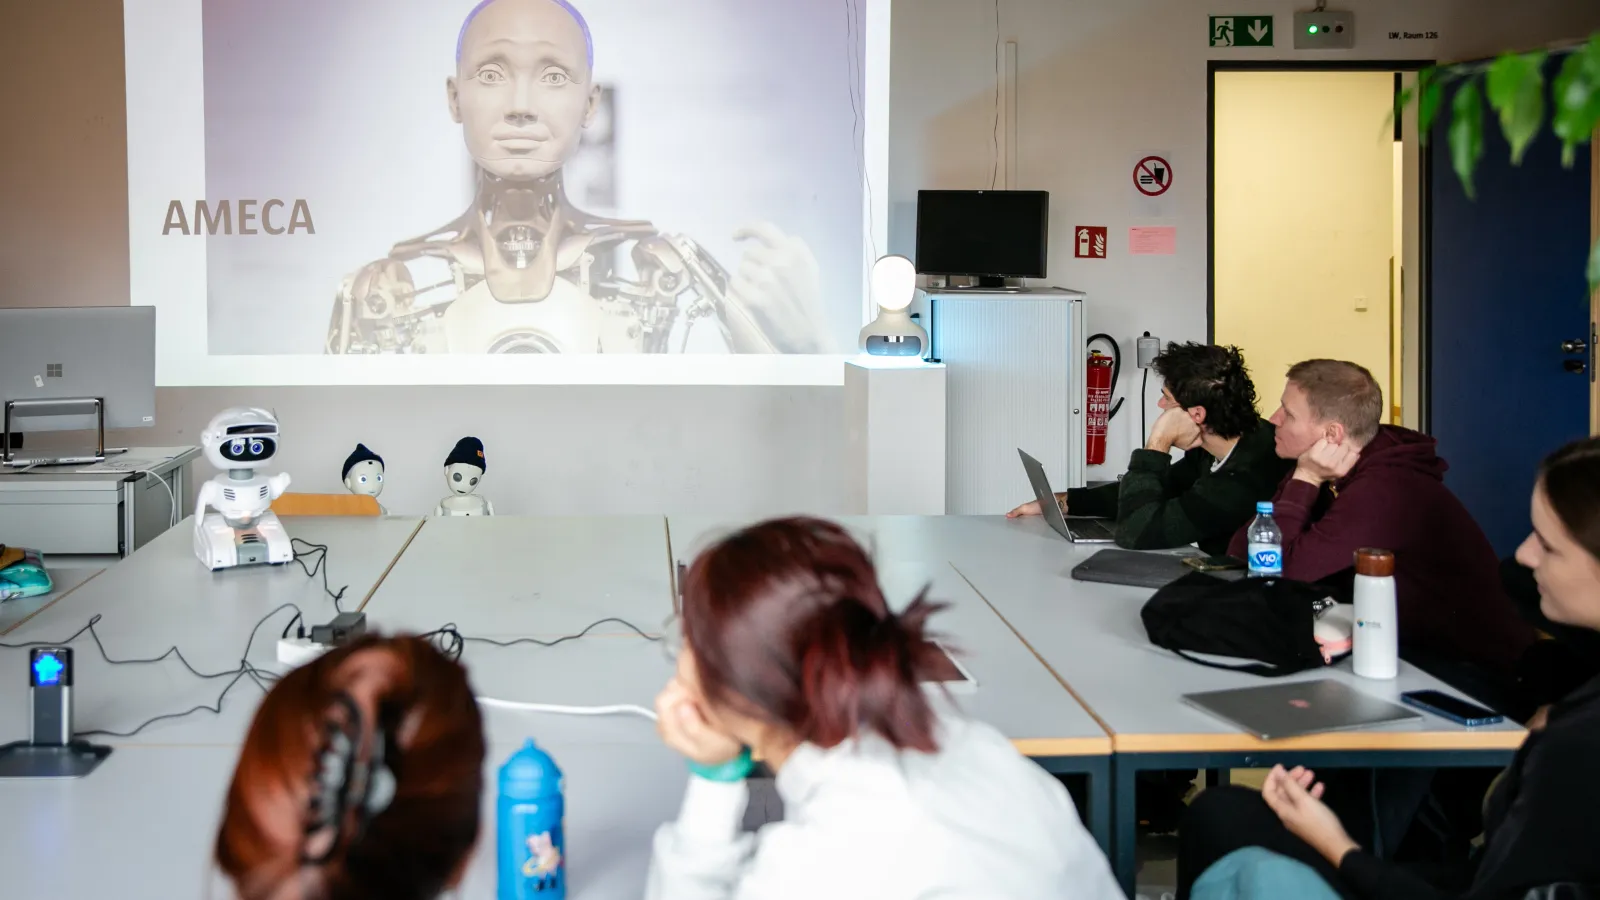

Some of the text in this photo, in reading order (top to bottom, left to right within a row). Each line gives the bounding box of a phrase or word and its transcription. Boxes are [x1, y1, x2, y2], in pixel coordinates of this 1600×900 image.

[1403, 31, 1424, 39] Raum
[1425, 31, 1438, 39] 126
[162, 199, 316, 235] AMECA
